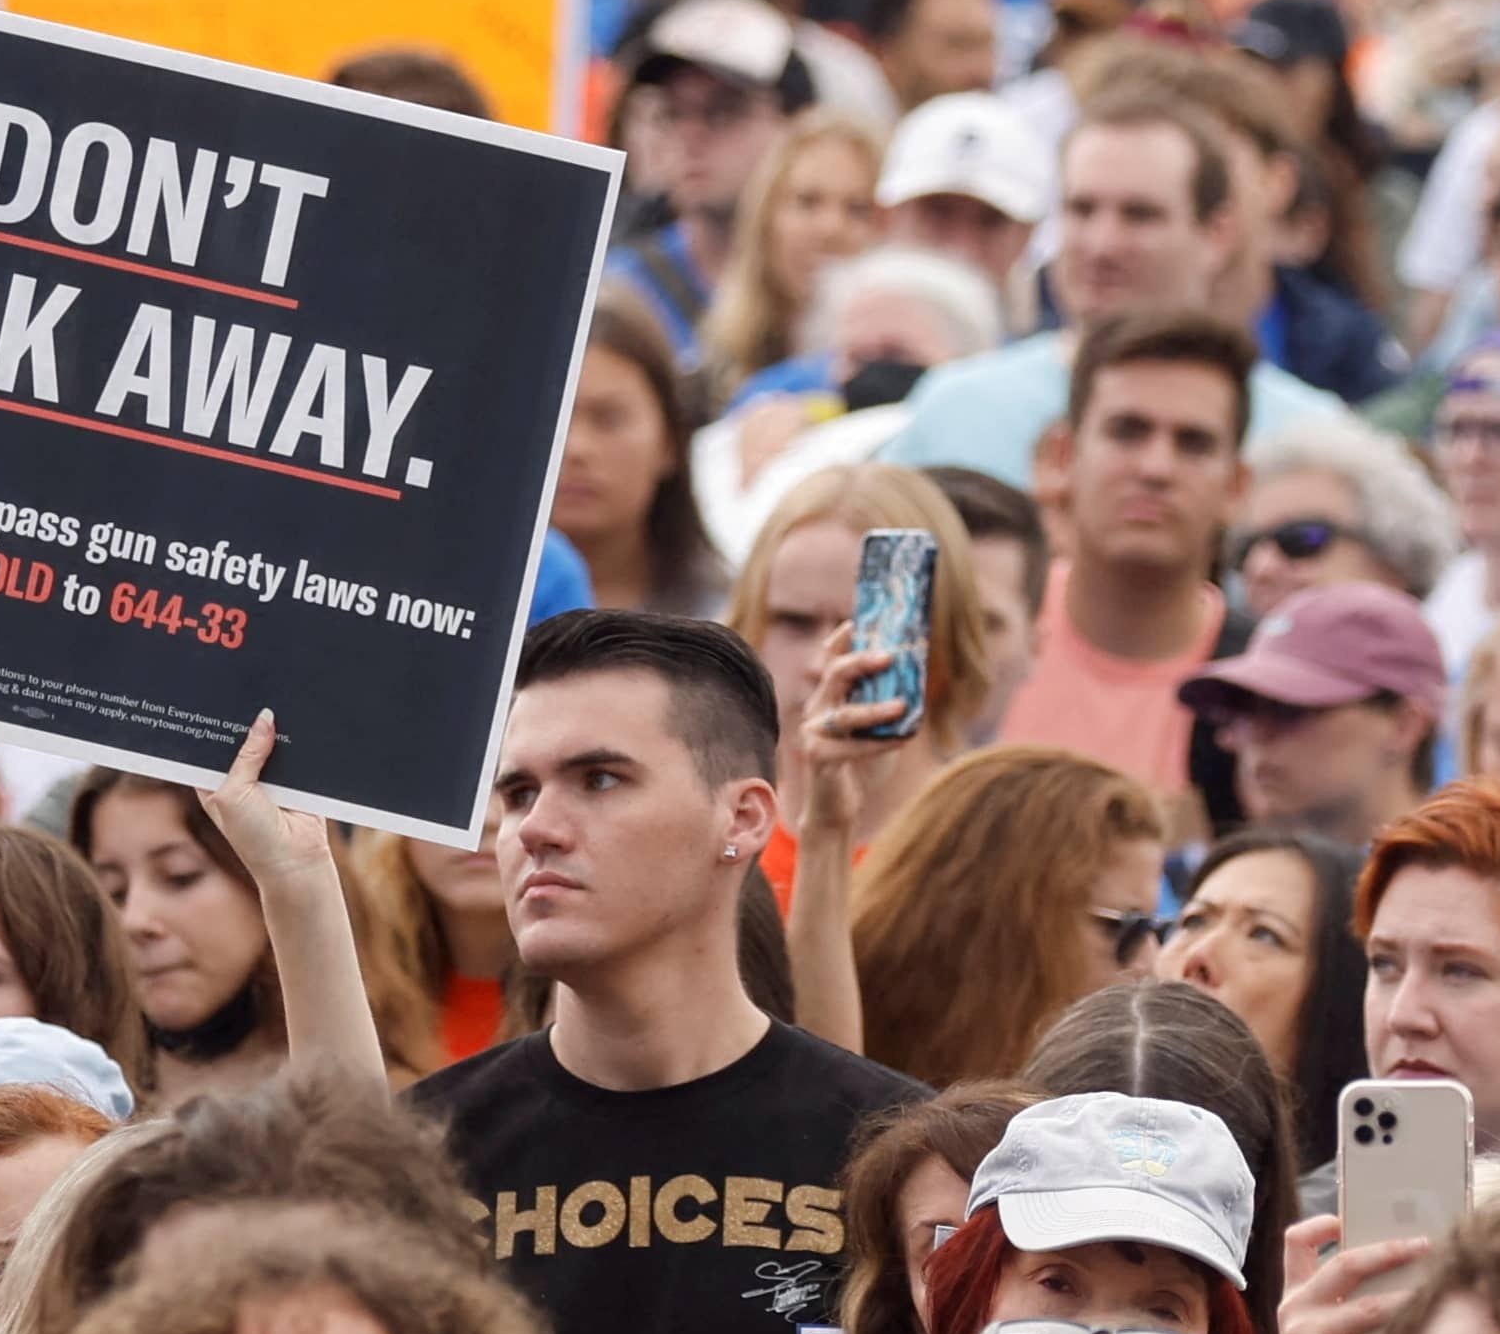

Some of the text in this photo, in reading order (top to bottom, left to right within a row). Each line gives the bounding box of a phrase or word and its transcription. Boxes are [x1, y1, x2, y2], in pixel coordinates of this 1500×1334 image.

[94, 303, 433, 488] AWAY.
[63, 574, 100, 615] to
[110, 582, 247, 649] 644-33
[85, 522, 156, 565] gun
[165, 540, 287, 602] safety
[292, 559, 378, 616] laws
[386, 592, 475, 639] now:
[10, 683, 20, 695] &
[21, 686, 45, 700] data
[46, 694, 73, 707] rates
[74, 700, 98, 714] may
[98, 706, 128, 721] apply.
[130, 713, 235, 745] everytown.org/terms
[28, 674, 40, 685] to
[40, 678, 64, 691] your
[64, 683, 99, 699] phone
[99, 692, 140, 708] number
[141, 699, 166, 714] from
[167, 705, 221, 728] Everytown
[465, 1174, 845, 1259] HOICES
